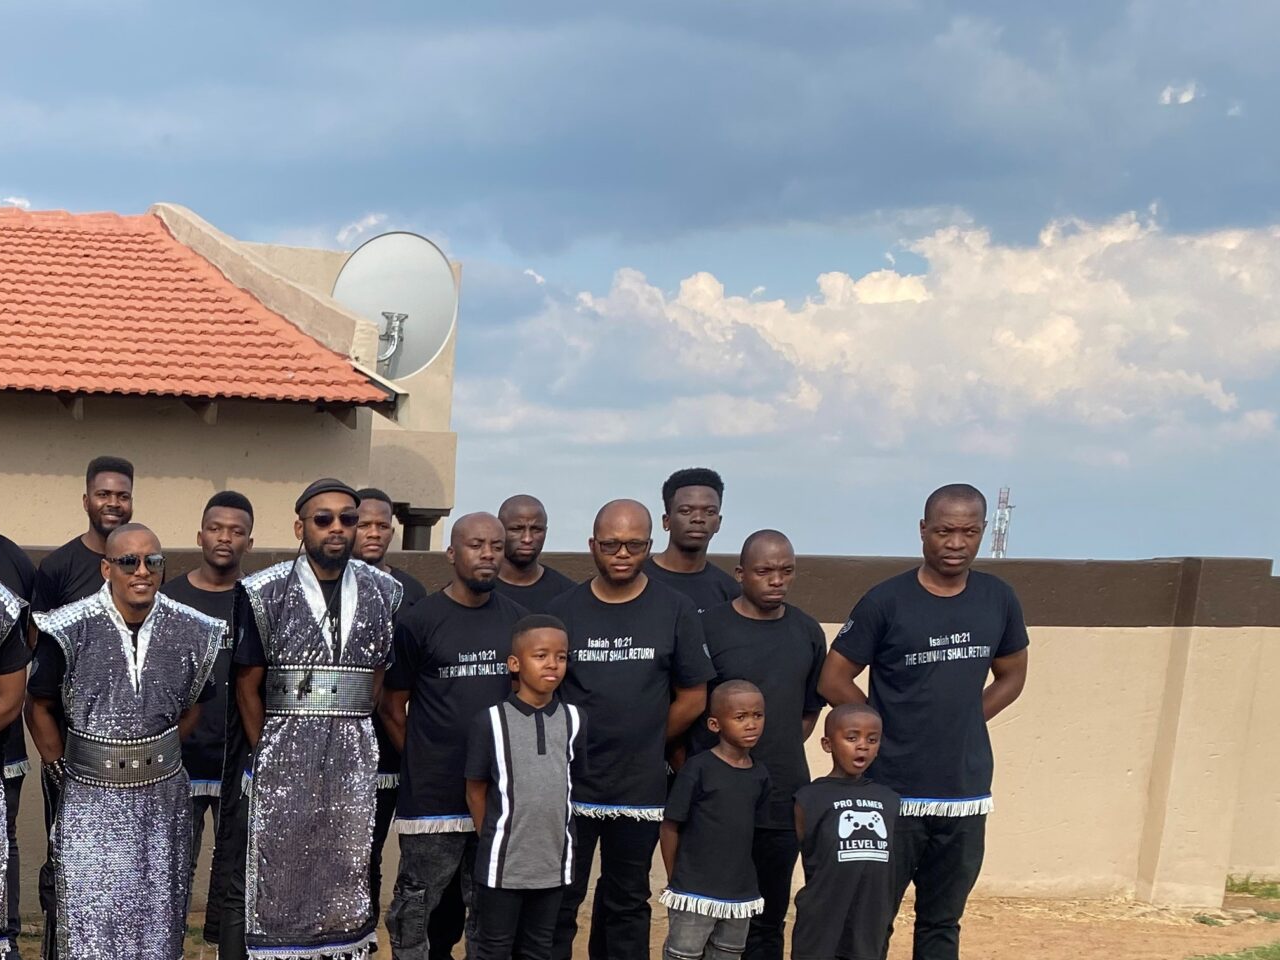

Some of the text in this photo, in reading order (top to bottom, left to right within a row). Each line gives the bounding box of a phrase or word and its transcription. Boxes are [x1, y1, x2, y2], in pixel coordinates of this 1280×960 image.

[588, 637, 632, 648] Isaiah 10:21
[929, 632, 970, 646] Isaiah 10:21
[459, 650, 496, 662] Isaiah 10:21
[578, 650, 609, 662] REMNANT
[609, 649, 628, 662] SHALL
[629, 648, 655, 659] RETURN
[905, 654, 916, 665] THE
[947, 647, 968, 660] SHALL
[478, 664, 496, 675] SHALL
[833, 799, 884, 810] PRO GAMER
[840, 840, 888, 849] I LEVEL UP
